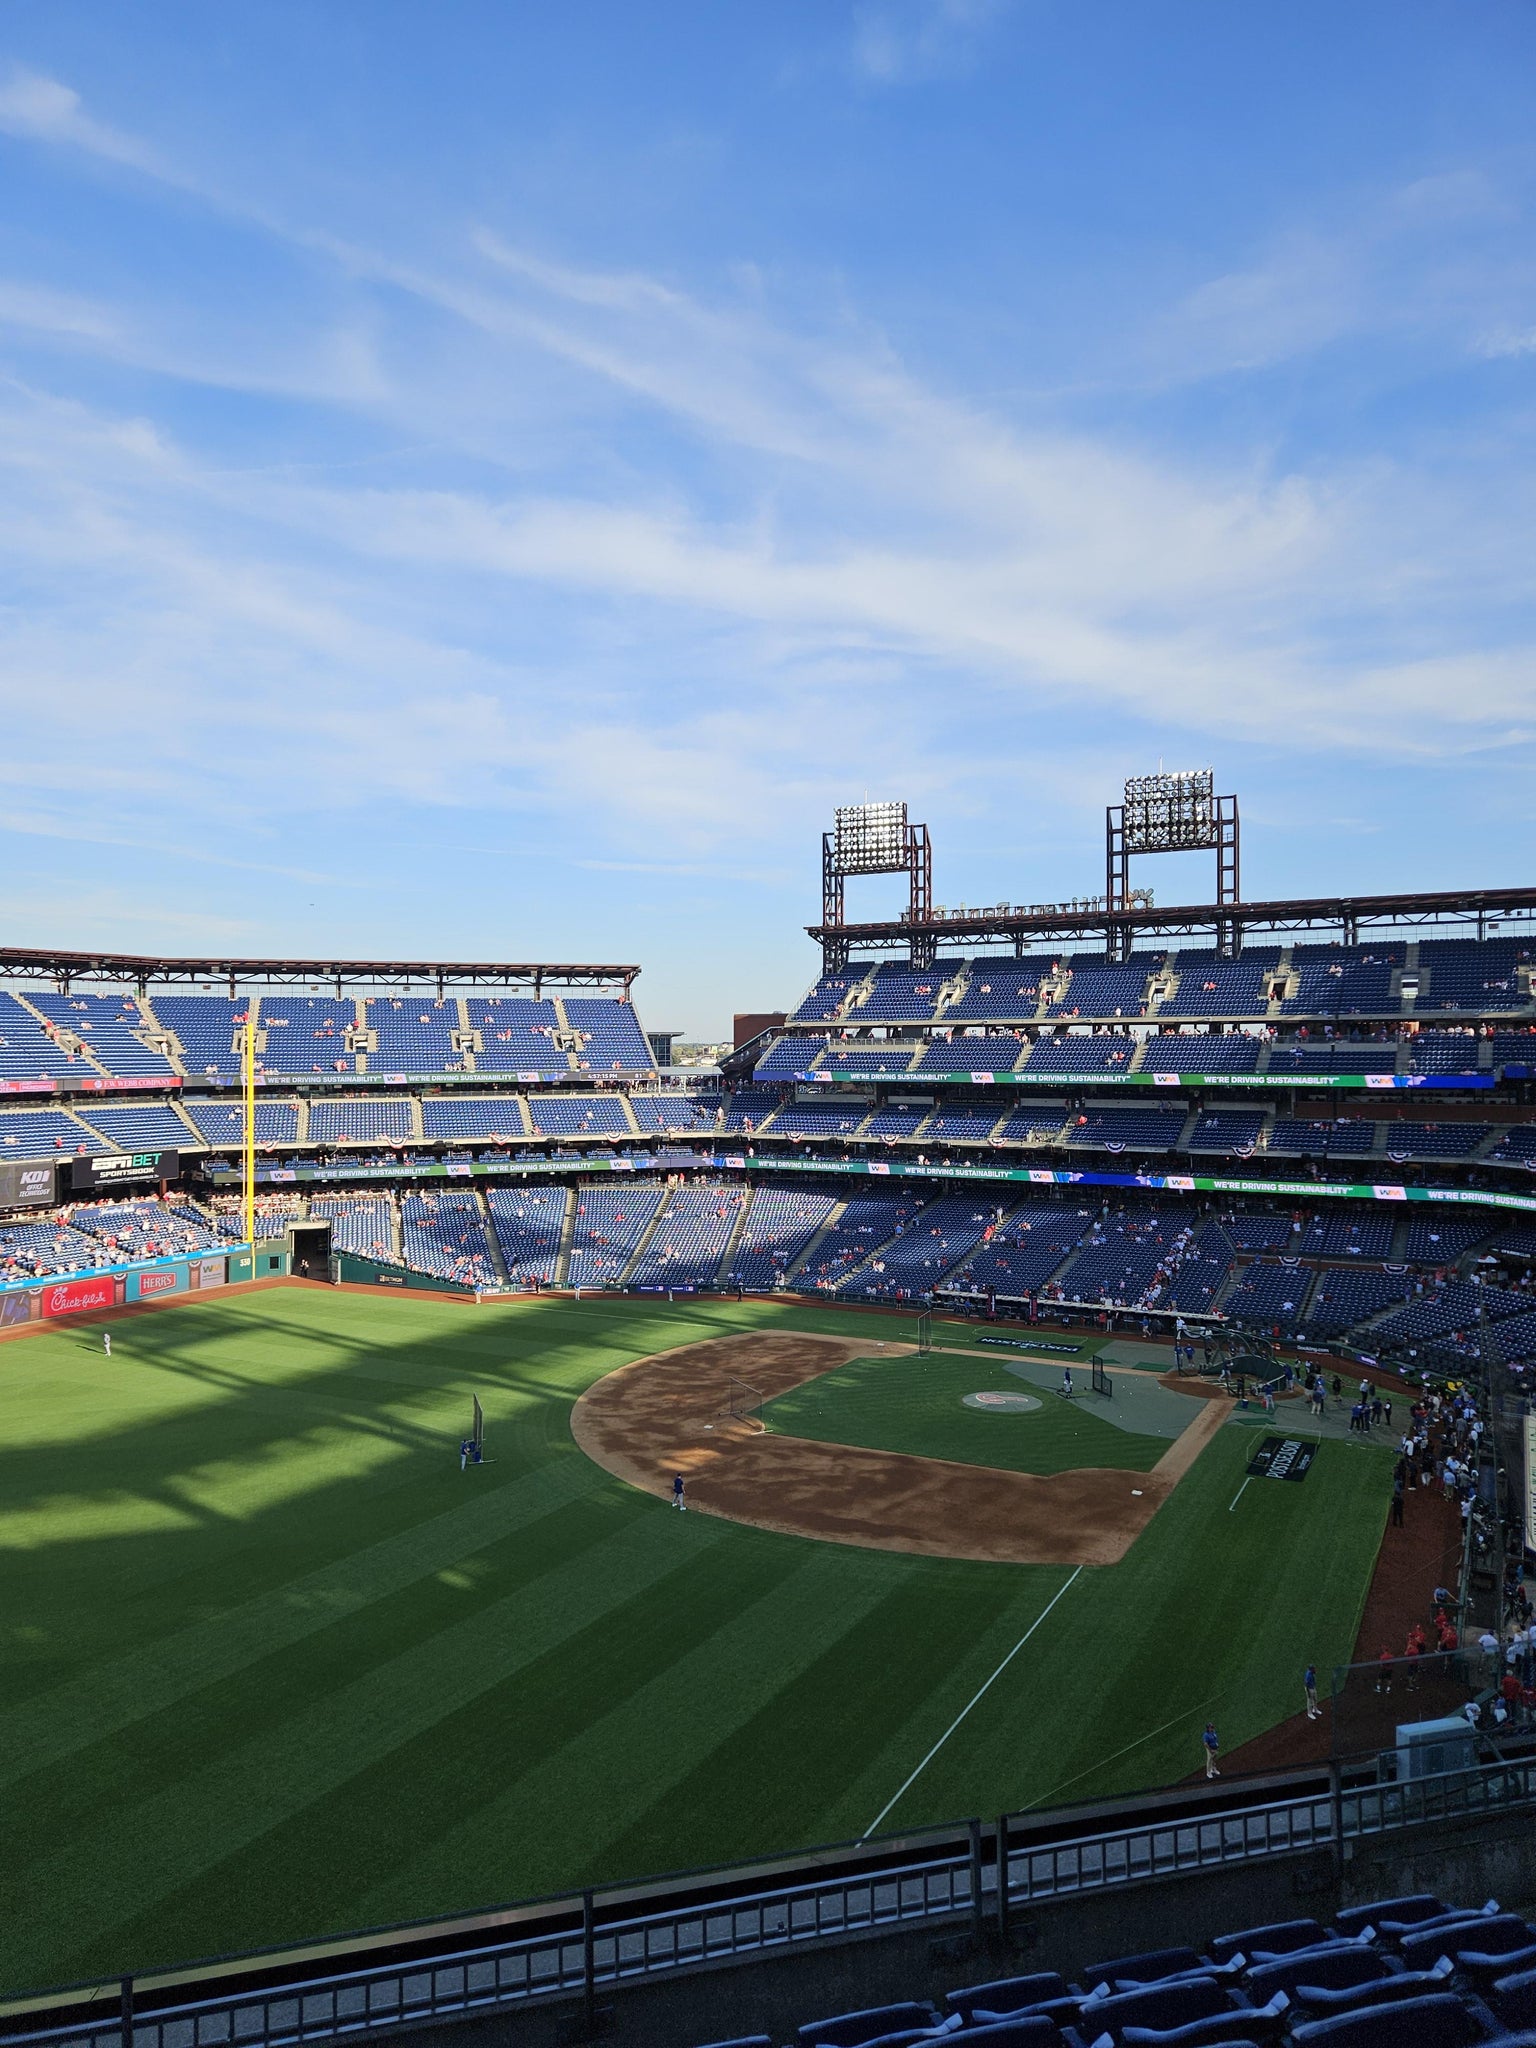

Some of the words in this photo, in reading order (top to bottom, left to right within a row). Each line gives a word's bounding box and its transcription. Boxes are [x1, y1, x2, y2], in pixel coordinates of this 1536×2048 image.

[138, 1079, 171, 1087] COMPANY
[1231, 1076, 1265, 1084] DRIVING
[91, 1155, 132, 1171] ESPN
[132, 1153, 162, 1167] BET
[20, 1170, 50, 1184] KDI
[100, 1167, 155, 1178] SPORTSBOOK
[1214, 1181, 1240, 1189] WE'RE
[1242, 1182, 1276, 1190] DRIVING
[1427, 1191, 1459, 1199] WE'RE
[1460, 1192, 1494, 1203] DRIVING
[143, 1275, 172, 1289] HERR'S
[1266, 1440, 1303, 1479] POSTSEASON
